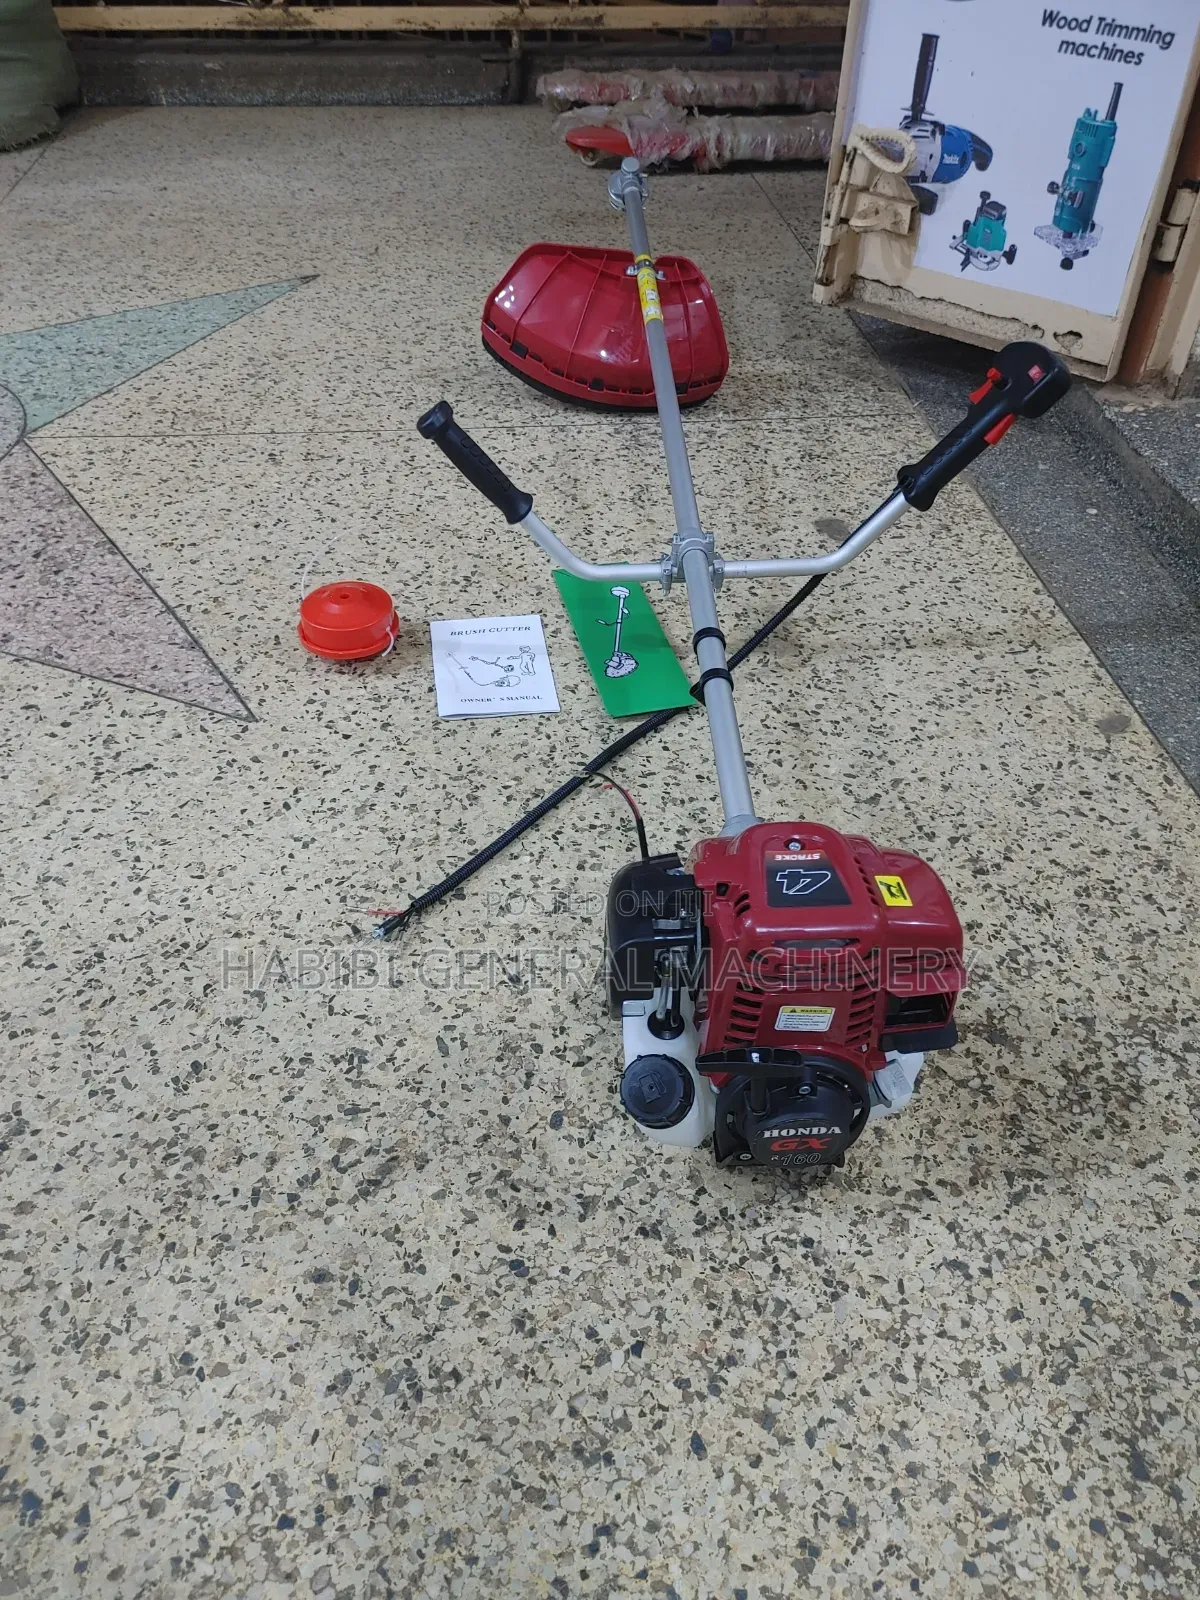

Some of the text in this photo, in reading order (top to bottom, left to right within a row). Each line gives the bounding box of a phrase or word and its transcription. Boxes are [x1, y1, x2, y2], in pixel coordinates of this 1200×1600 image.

[1041, 9, 1176, 51] Wood Trimming
[1057, 40, 1145, 66] machines
[450, 628, 486, 636] BRUSH
[774, 853, 821, 861] STROKE
[776, 869, 831, 894] 4
[763, 1126, 842, 1138] HONDA
[769, 1137, 832, 1151] GX
[781, 1153, 821, 1165] 160
